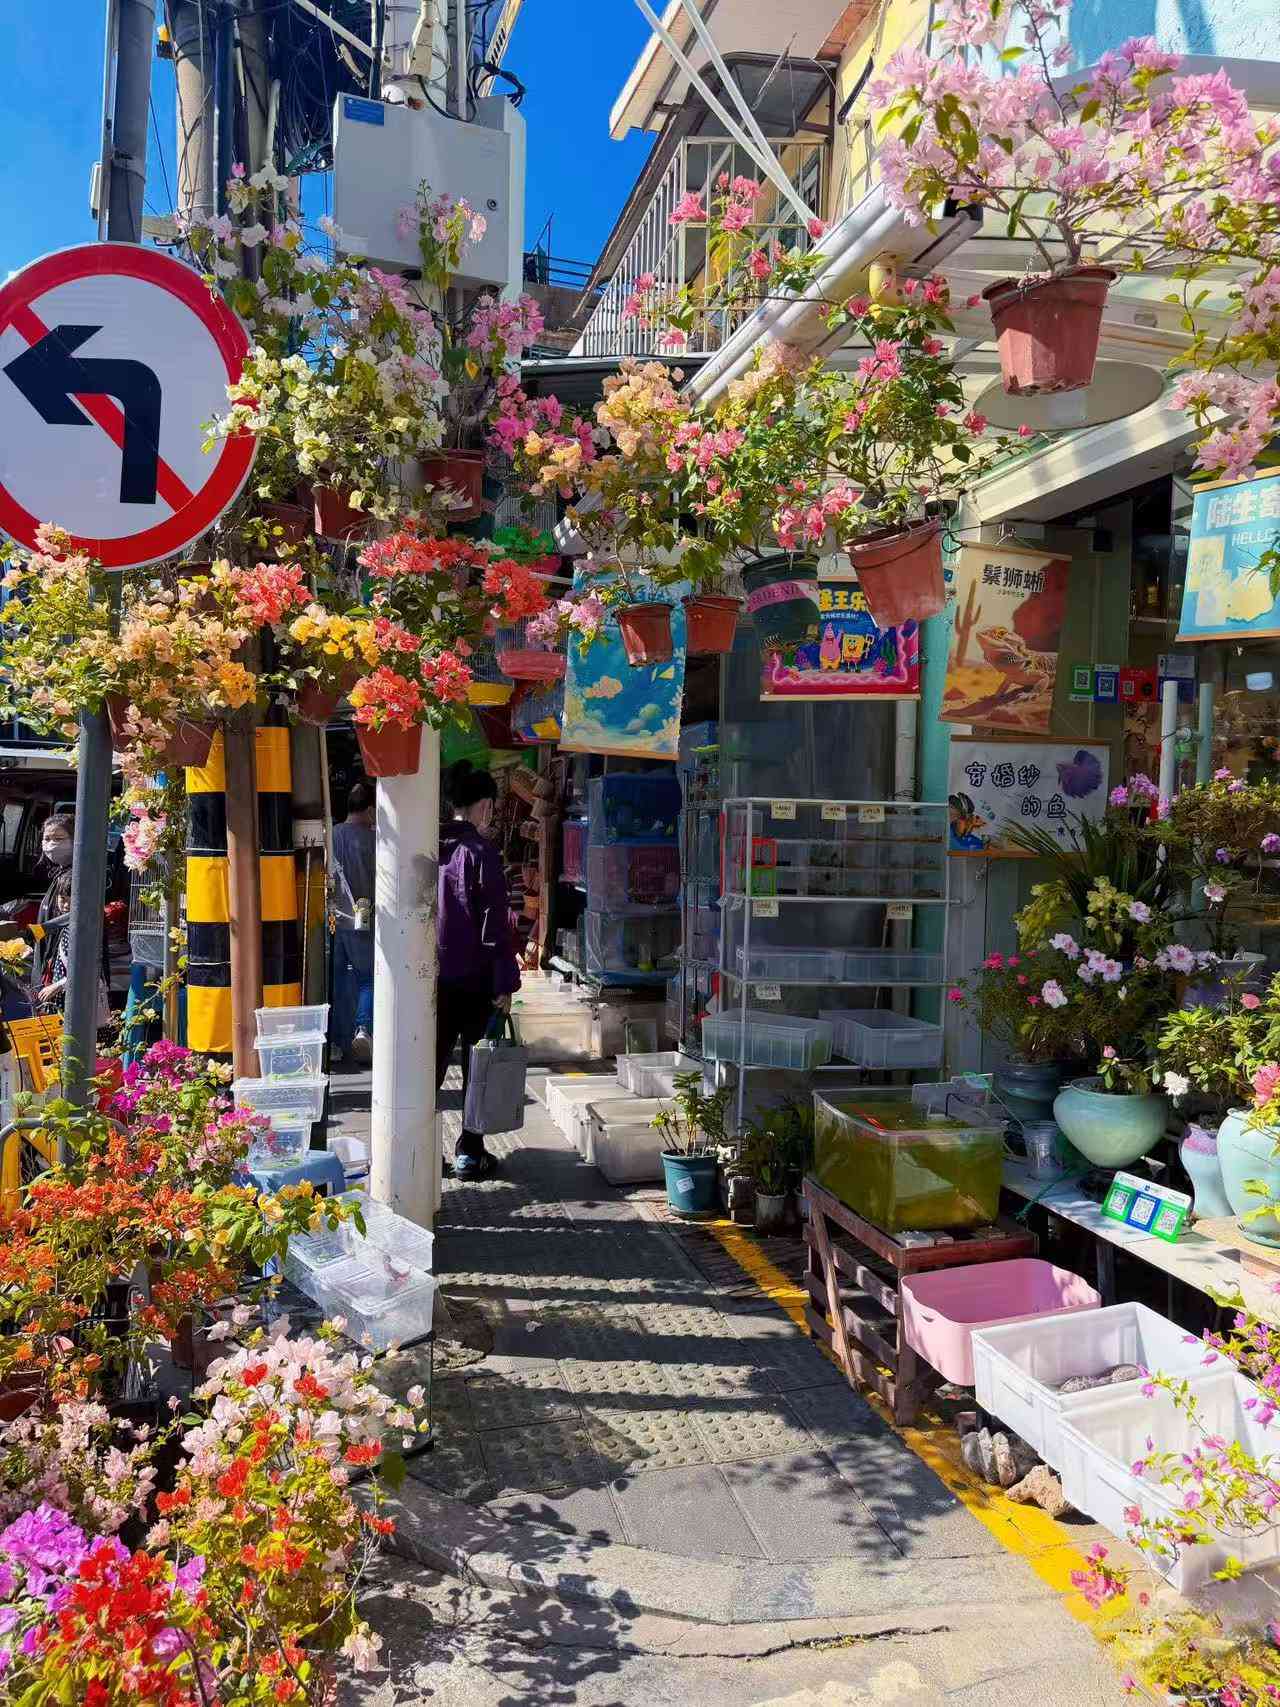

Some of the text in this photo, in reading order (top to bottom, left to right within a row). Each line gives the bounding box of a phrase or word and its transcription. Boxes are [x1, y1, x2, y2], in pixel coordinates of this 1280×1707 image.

[965, 761, 1041, 788] 穿婚纱
[1021, 793, 1067, 818] 的鱼
